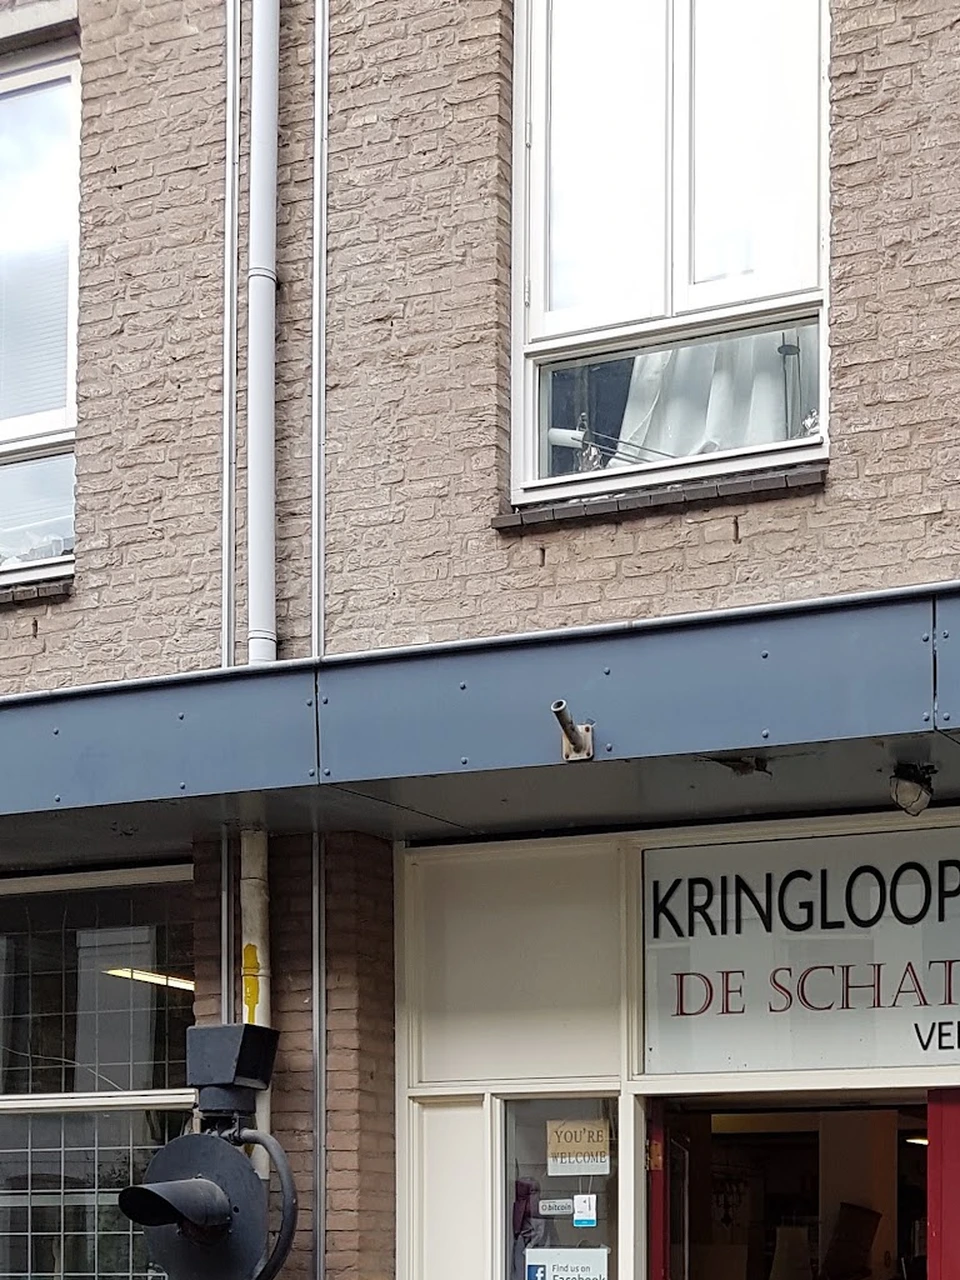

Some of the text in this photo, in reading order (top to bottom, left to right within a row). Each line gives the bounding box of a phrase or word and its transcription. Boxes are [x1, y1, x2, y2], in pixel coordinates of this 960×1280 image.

[670, 970, 746, 1017] DE
[554, 1127, 604, 1143] YOU'RE
[551, 1150, 607, 1164] WELCOME
[552, 1264, 569, 1273] Find
[570, 1265, 580, 1273] us
